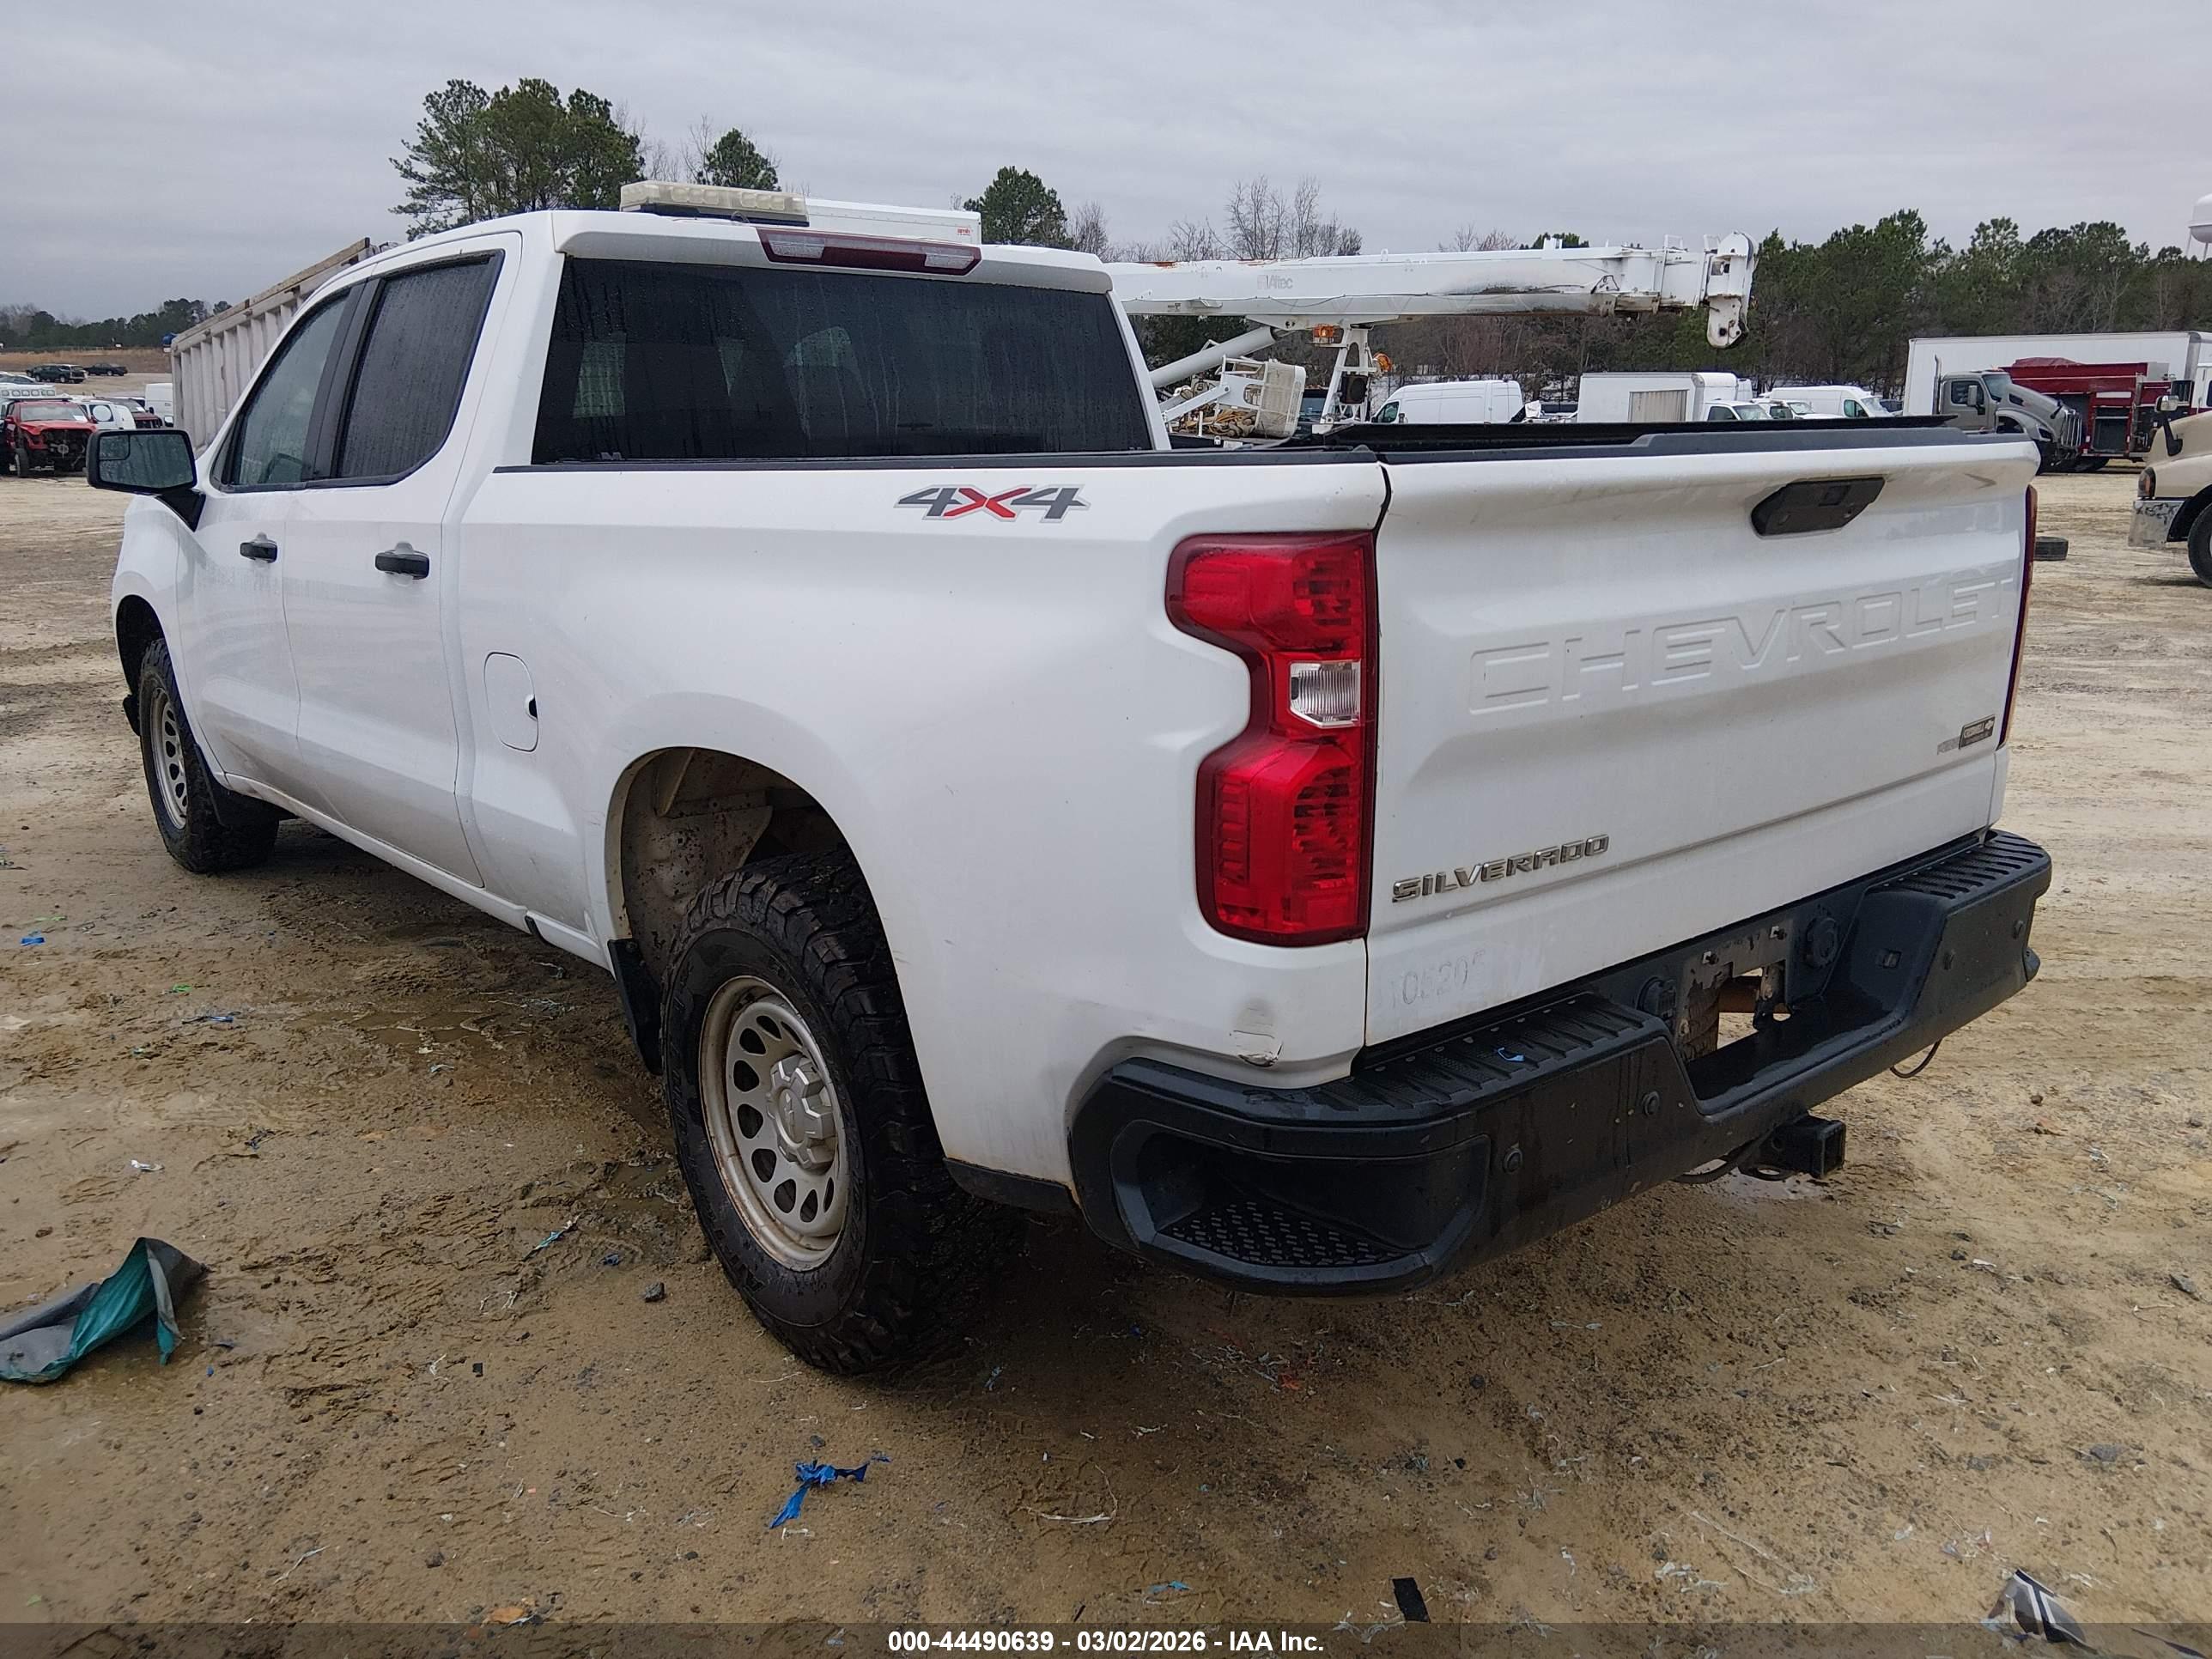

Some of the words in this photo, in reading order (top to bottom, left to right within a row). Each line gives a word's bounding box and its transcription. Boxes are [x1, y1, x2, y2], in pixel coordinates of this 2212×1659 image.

[1267, 275, 1294, 289] Altec
[1469, 576, 2014, 714] CHEVROLET
[1391, 833, 1609, 902] SILVERADO
